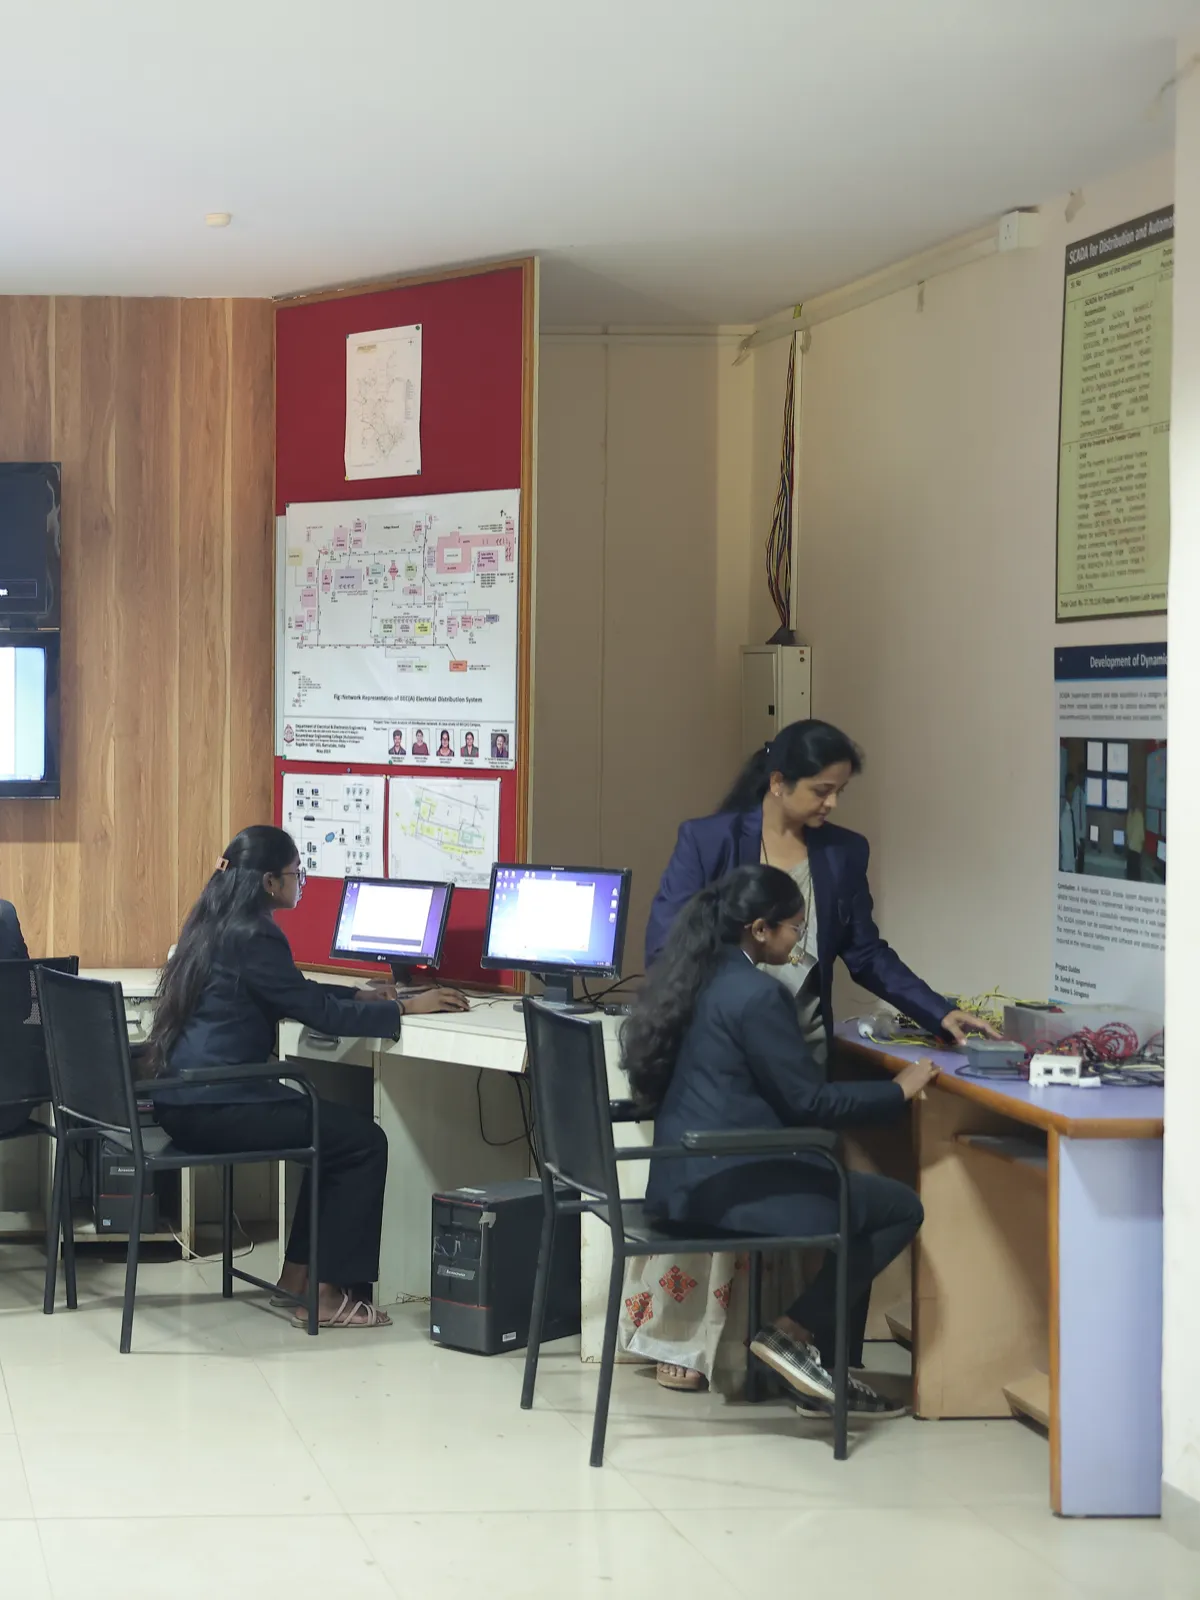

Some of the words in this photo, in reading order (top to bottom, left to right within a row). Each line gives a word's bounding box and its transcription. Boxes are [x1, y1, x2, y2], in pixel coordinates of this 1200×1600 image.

[1069, 246, 1089, 265] SCADA
[1089, 243, 1098, 258] for
[1099, 230, 1135, 255] Distribution
[1135, 223, 1147, 241] and
[1090, 655, 1131, 669] Development
[1132, 653, 1139, 666] of
